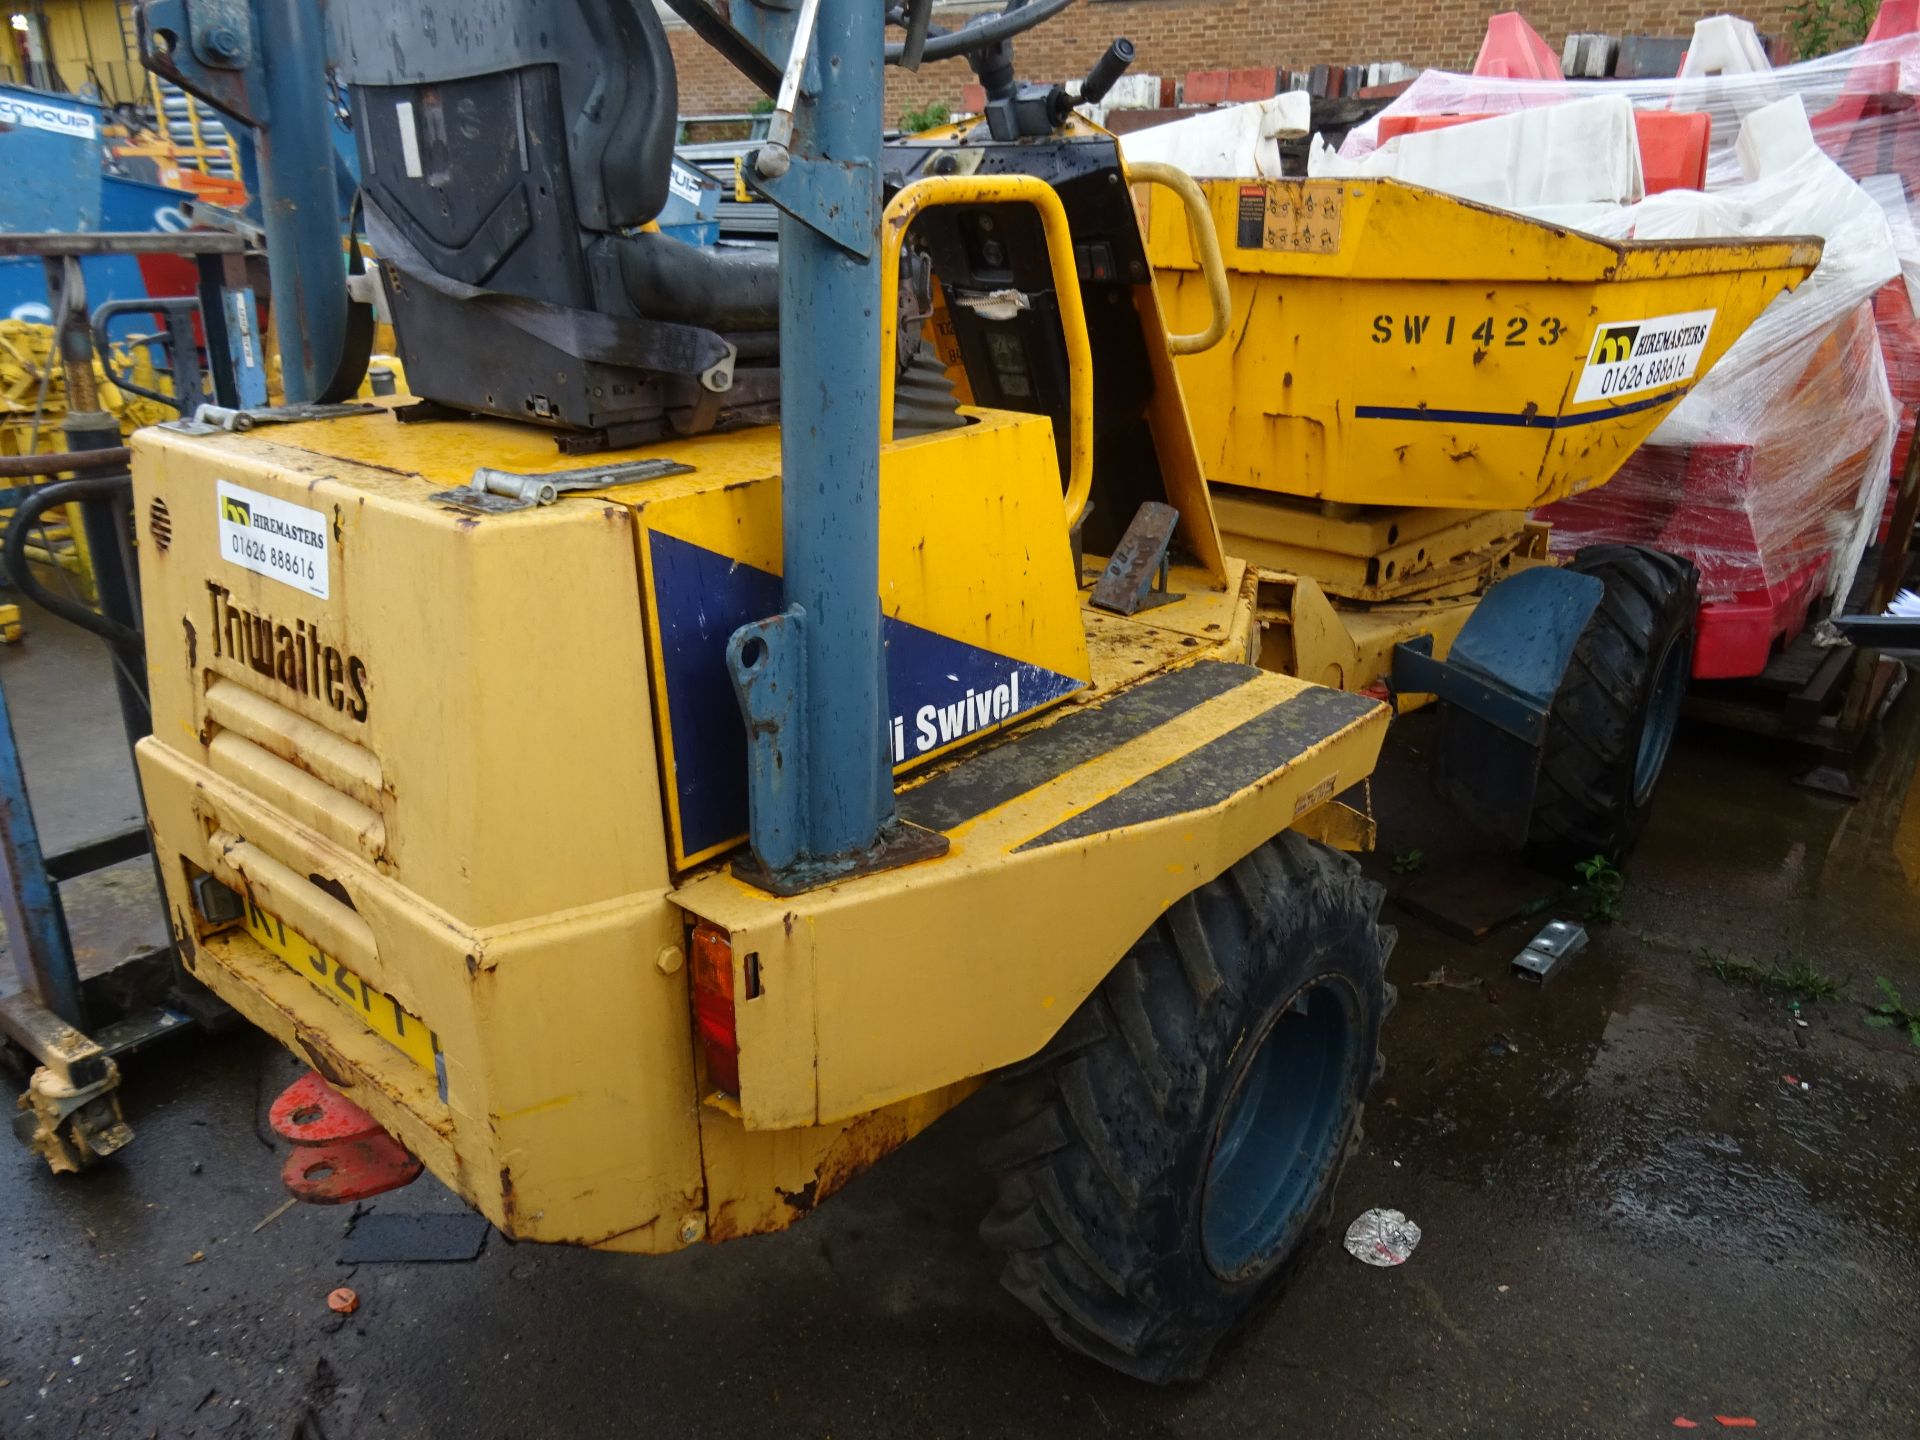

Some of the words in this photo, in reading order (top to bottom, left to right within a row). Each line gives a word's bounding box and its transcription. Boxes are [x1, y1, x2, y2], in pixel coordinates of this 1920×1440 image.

[0, 102, 89, 128] CONQUIP
[1634, 324, 1707, 357] HIREMASTERS
[1601, 362, 1643, 395] 01626
[1646, 353, 1687, 386] 888616
[253, 512, 324, 549] HIREMASTERS
[232, 534, 266, 563] 01626
[271, 547, 315, 580] 888616
[205, 579, 368, 724] Thwaites
[916, 671, 1019, 751] Swivel
